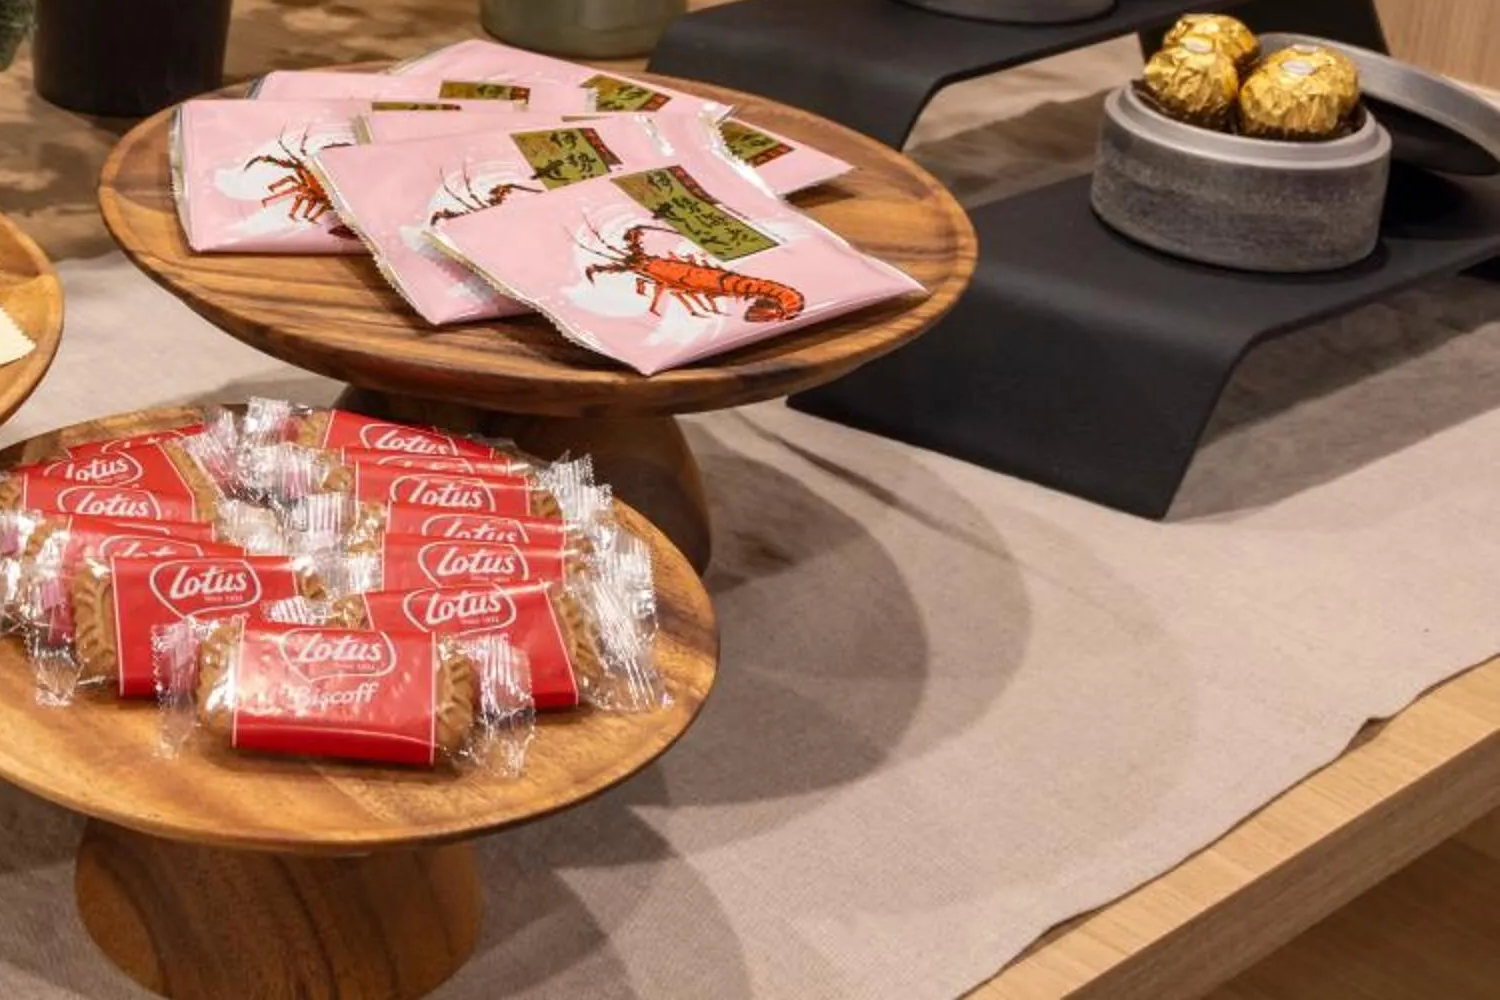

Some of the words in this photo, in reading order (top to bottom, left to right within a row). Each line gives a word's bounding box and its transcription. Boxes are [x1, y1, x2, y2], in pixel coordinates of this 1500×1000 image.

[374, 429, 453, 455] Lotus
[74, 491, 151, 518] Lotus
[409, 480, 484, 509] Lotus
[436, 547, 517, 577] Lotus
[169, 564, 249, 601] Lotus
[425, 589, 503, 625] Lotus
[292, 632, 383, 664] Lotus
